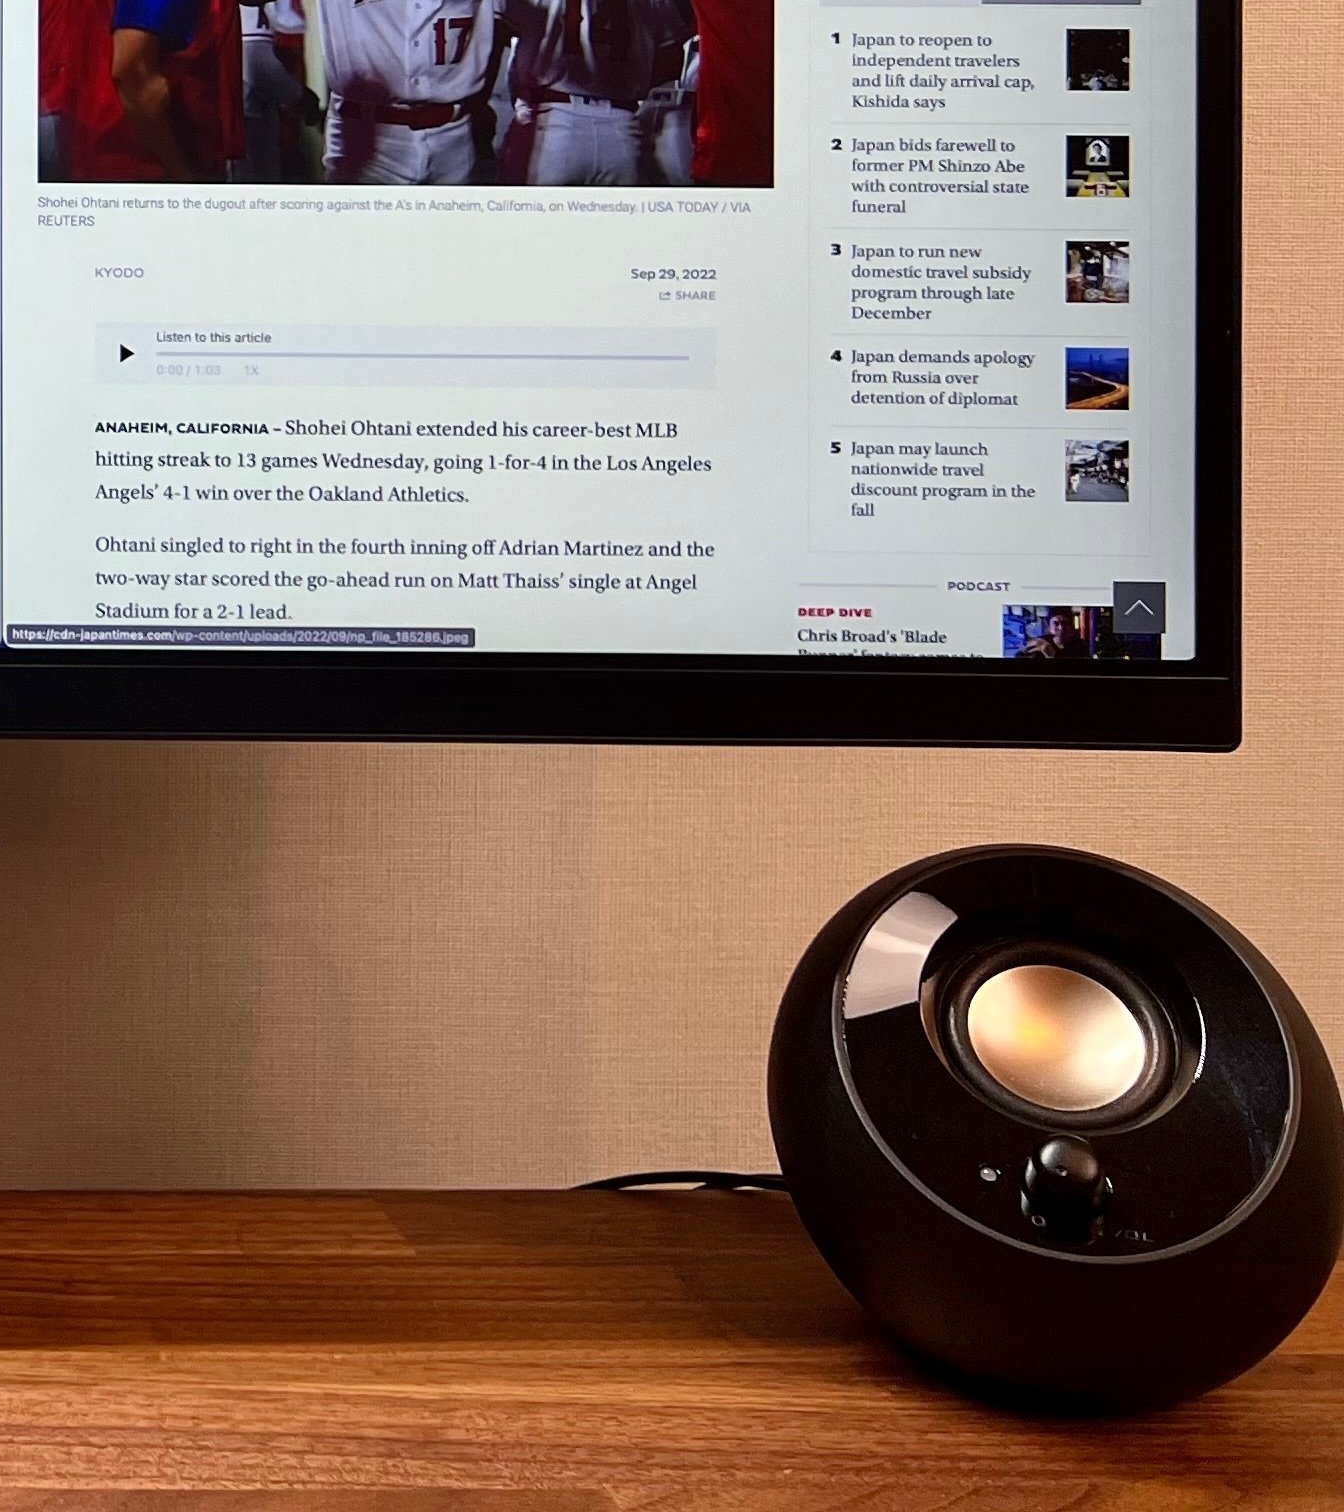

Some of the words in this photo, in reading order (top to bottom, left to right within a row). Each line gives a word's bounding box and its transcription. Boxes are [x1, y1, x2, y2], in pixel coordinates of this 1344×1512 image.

[433, 18, 472, 66] 17
[830, 32, 840, 45] 1
[853, 33, 895, 49] Japan
[900, 35, 915, 46] to
[919, 37, 972, 50] reopen
[977, 36, 992, 46] to
[853, 53, 951, 70] independent
[955, 54, 1020, 67] travelers
[95, 268, 144, 278] KYODO
[157, 332, 191, 342] Listen
[195, 333, 206, 342] to
[210, 333, 231, 342] this
[235, 333, 271, 343] article
[95, 423, 172, 435] ANAHEIM,
[177, 423, 269, 434] CALIFORNIA
[164, 486, 190, 500] 4-1
[196, 485, 229, 500] win
[234, 490, 272, 500] over
[277, 485, 304, 501] the
[309, 486, 383, 501] Oakland
[388, 486, 469, 502] Athletics.
